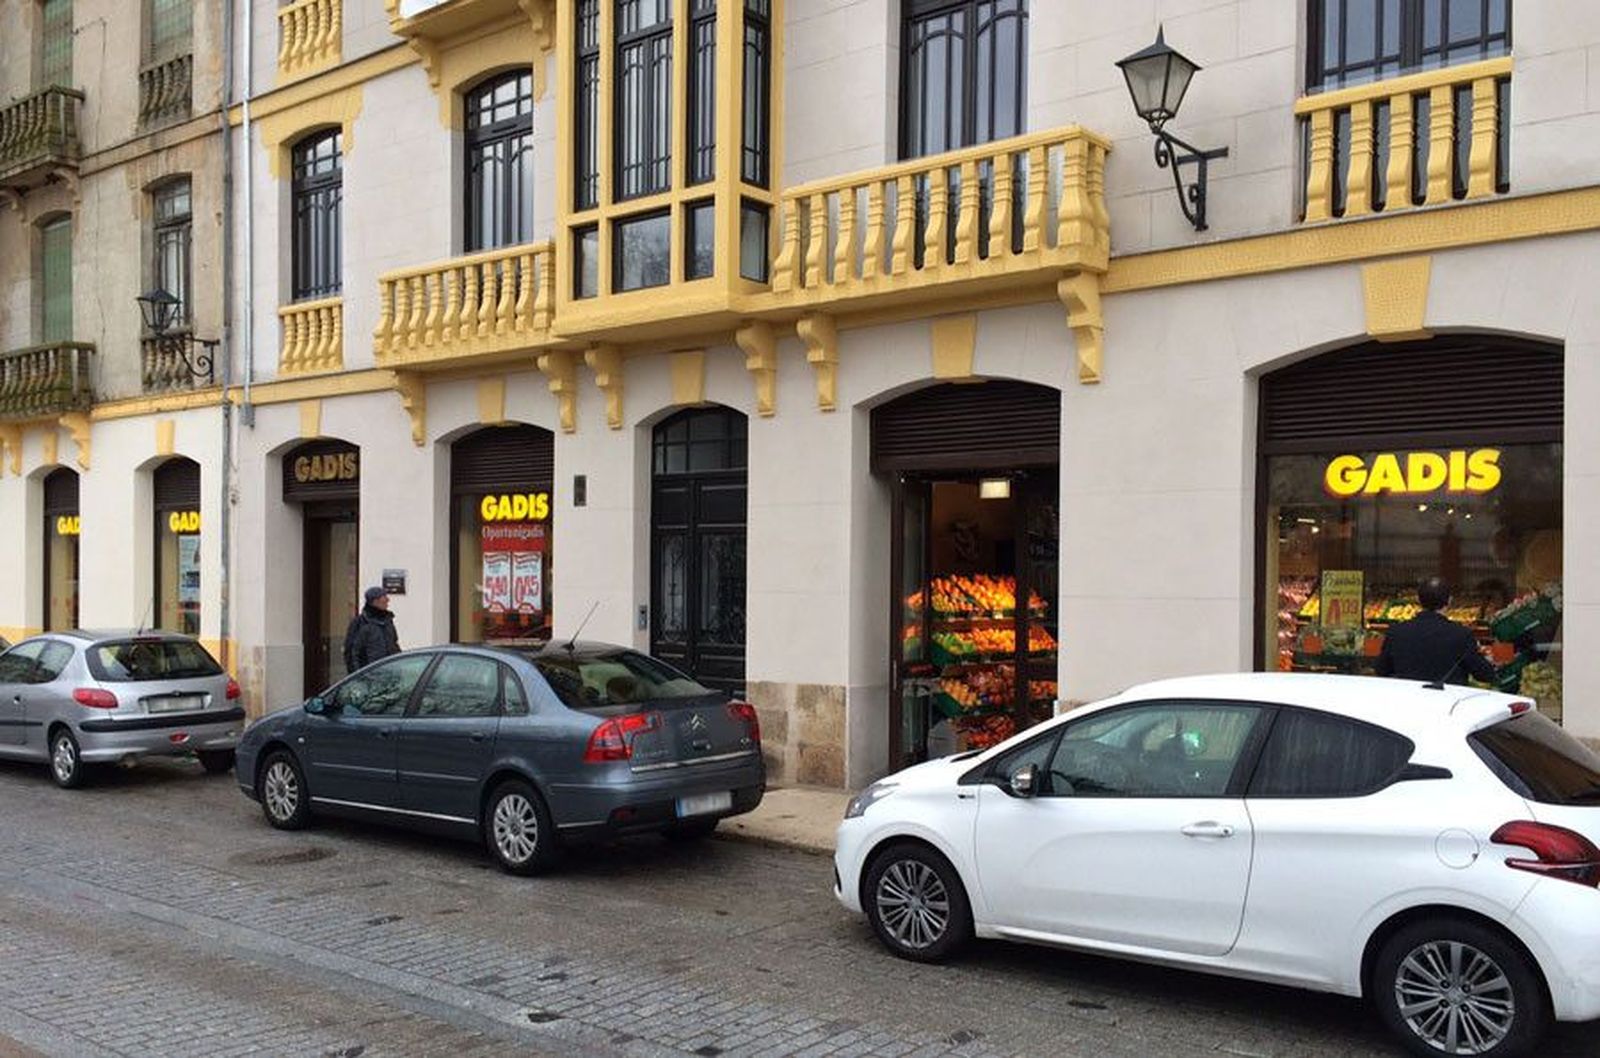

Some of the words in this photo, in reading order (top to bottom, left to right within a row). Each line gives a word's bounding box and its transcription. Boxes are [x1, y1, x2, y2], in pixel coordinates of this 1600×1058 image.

[294, 453, 358, 483] GADIS
[1325, 449, 1502, 497] GADIS
[481, 493, 549, 521] GADIS
